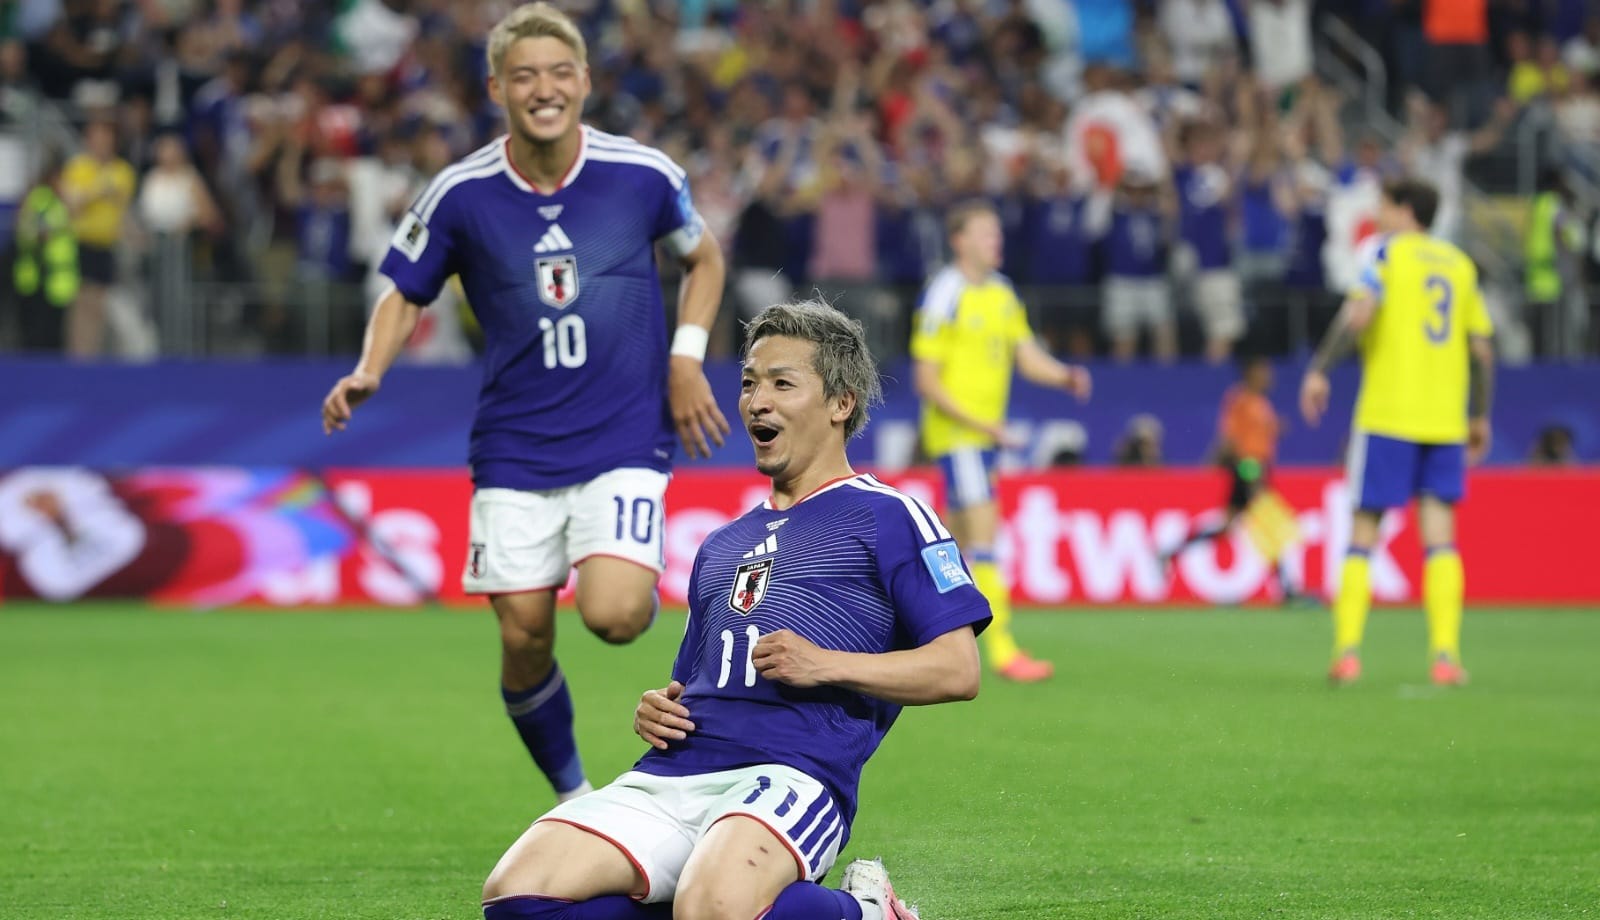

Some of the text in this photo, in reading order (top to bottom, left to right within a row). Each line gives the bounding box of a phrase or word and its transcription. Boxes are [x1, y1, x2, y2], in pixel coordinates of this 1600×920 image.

[1424, 274, 1453, 346] 3
[538, 314, 587, 369] 10
[613, 495, 654, 544] 10
[747, 562, 765, 571] JAPAN
[717, 625, 760, 688] 11
